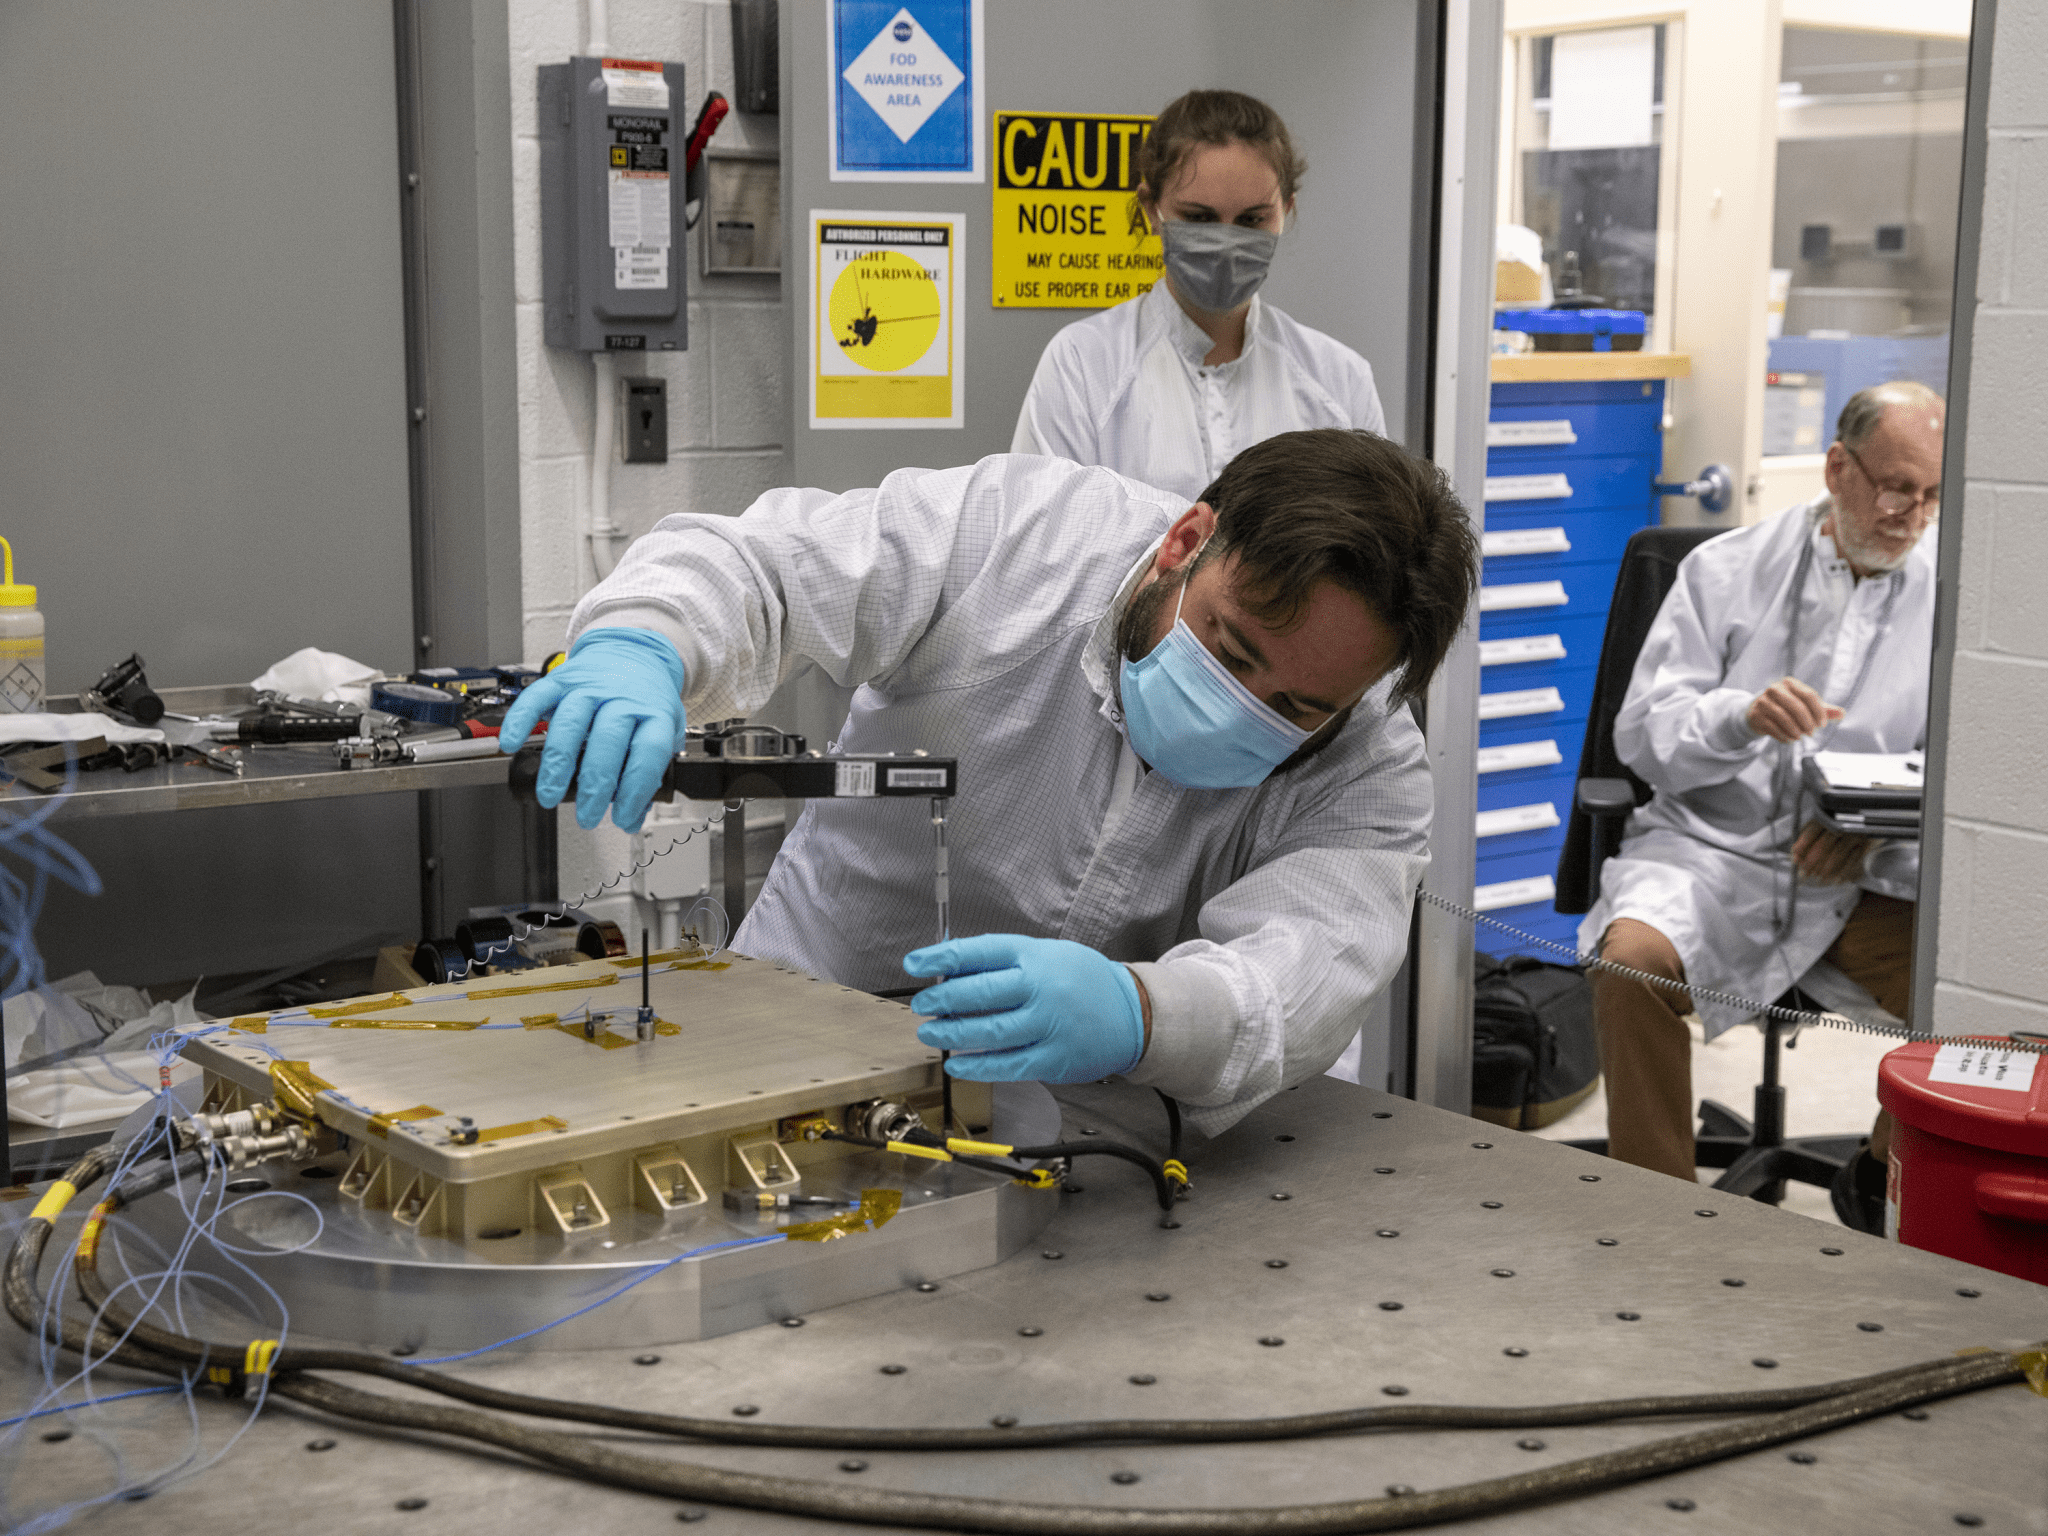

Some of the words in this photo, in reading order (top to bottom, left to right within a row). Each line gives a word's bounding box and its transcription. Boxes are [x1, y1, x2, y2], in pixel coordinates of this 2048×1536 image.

[890, 53, 917, 66] FOD
[864, 73, 943, 87] AWARENESS
[887, 94, 922, 106] AREA
[1018, 203, 1106, 235] NOISE
[826, 228, 877, 242] AUTHORIZED
[878, 230, 923, 243] PERSONNEL
[924, 231, 945, 243] ONLY
[836, 249, 888, 262] FLIGHT
[1027, 253, 1052, 268] MAY
[1059, 253, 1100, 269] CAUSE
[1107, 254, 1163, 270] HEARING
[861, 268, 942, 281] HARDWARE
[1015, 281, 1040, 298] USE
[1048, 281, 1098, 298] PROPER
[1105, 282, 1130, 298] EAR
